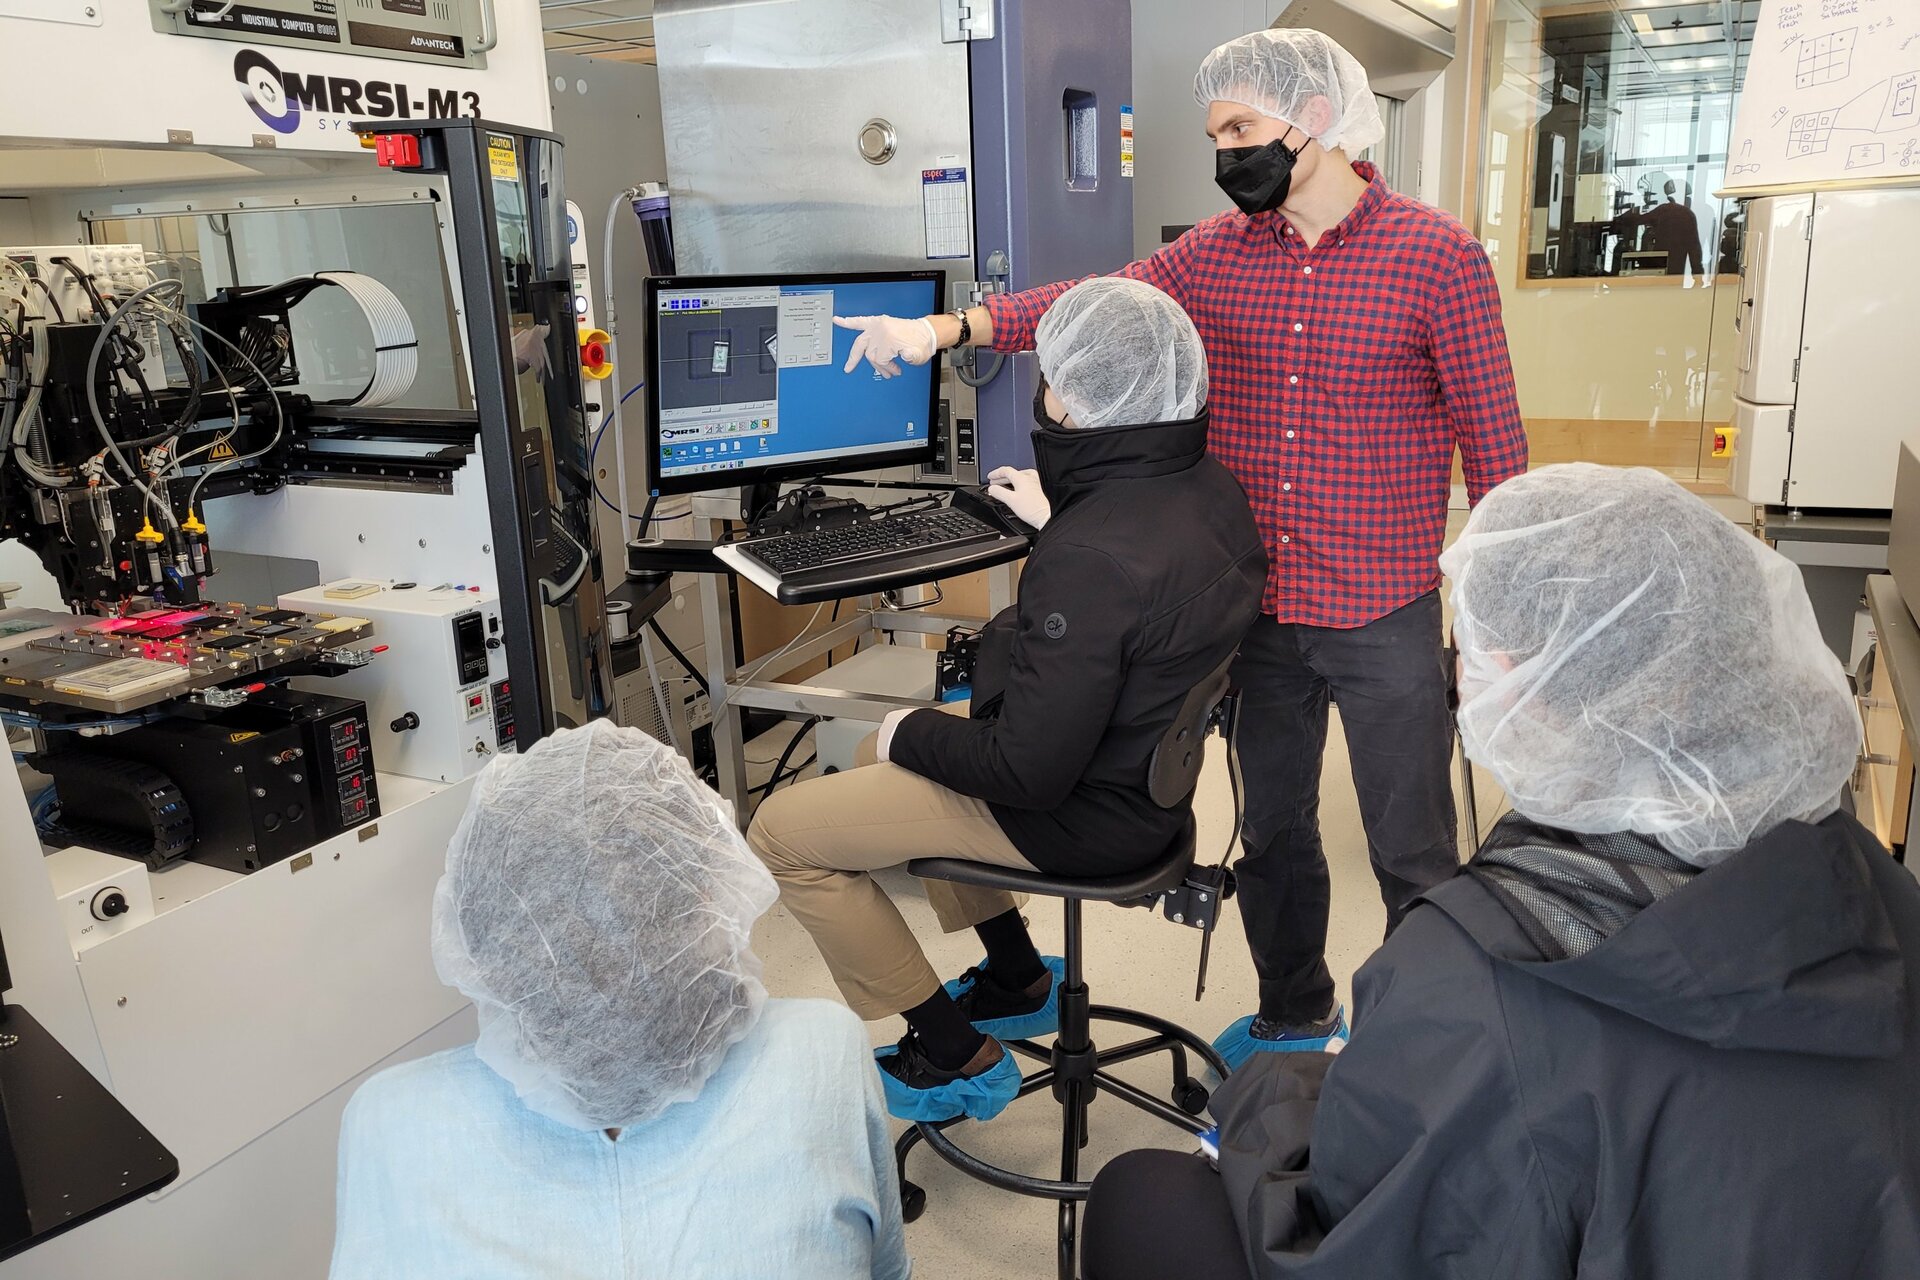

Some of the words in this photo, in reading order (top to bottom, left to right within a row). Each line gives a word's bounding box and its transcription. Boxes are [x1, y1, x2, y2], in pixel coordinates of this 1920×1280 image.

[1780, 3, 1803, 14] Teach
[1778, 11, 1803, 21] Teach
[241, 13, 279, 28] INDUSTRIAL
[281, 18, 315, 33] COMPUTER
[1777, 20, 1799, 30] Teach
[410, 35, 455, 51] ADVANTECH
[281, 71, 482, 120] MRSI-M3
[490, 136, 512, 149] CAUTION
[526, 443, 532, 452] 2
[81, 925, 94, 935] OUT
